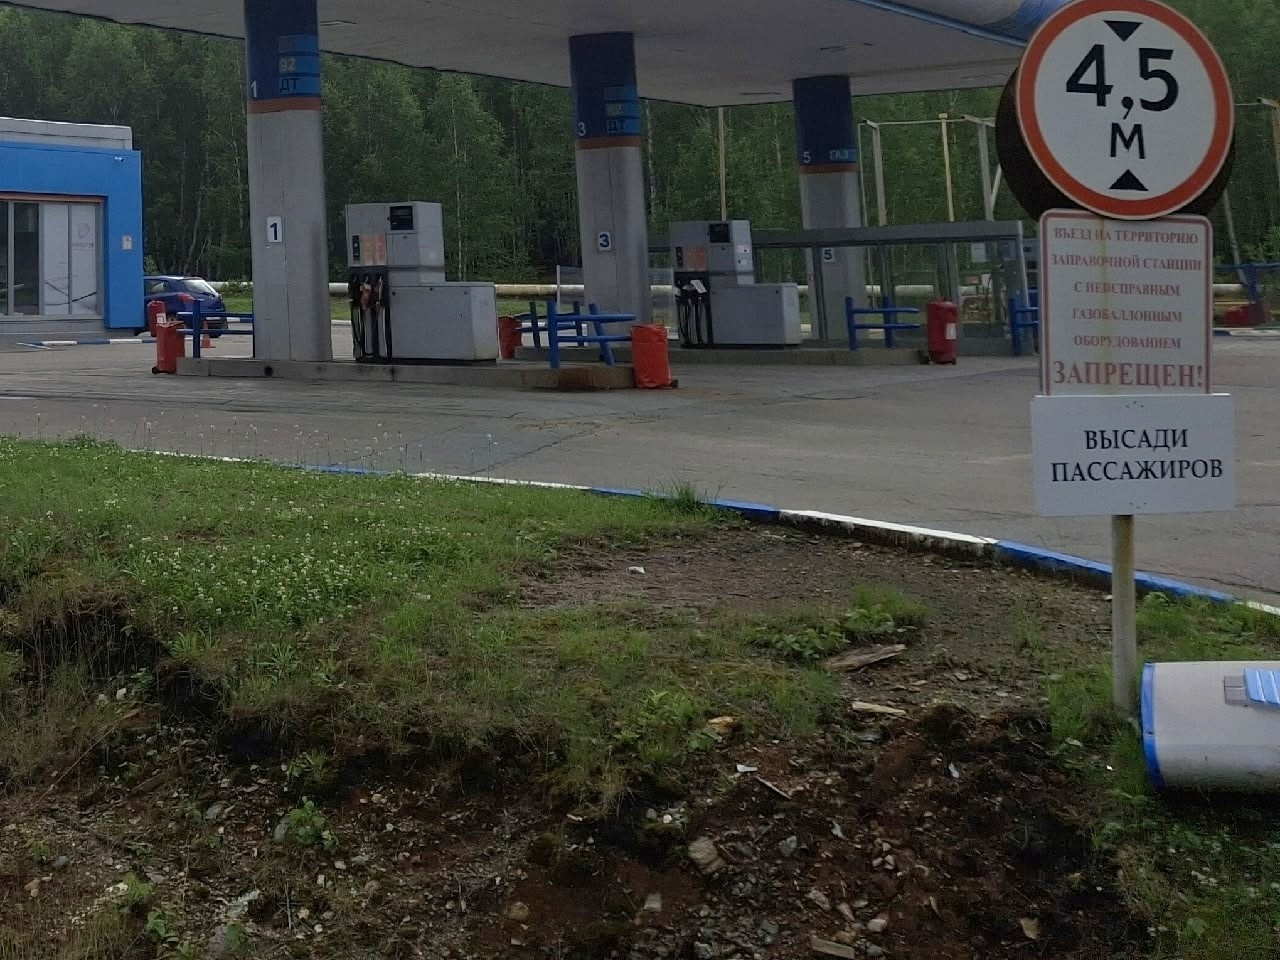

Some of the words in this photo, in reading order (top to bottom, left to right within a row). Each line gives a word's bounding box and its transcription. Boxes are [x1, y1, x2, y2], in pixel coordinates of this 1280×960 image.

[251, 80, 257, 98] 1
[1065, 43, 1179, 119] 4,5
[578, 121, 586, 137] 3
[803, 151, 811, 164] 5
[270, 222, 278, 241] 1
[1115, 230, 1198, 245] ТЕРРИТОРИЮ
[599, 233, 610, 248] 3
[823, 249, 833, 261] 5
[1051, 253, 1140, 269] ЗАПРАВОЧНОЙ
[1143, 257, 1201, 271] СТАНЦИИ
[1074, 281, 1083, 293] С
[1072, 307, 1183, 324] ГАЗОБАЛЛОННЫМ
[1074, 334, 1182, 350] ОБОРУДОВАНИЕМ
[1053, 360, 1203, 390] ЗАПРЕЩЕН!
[1084, 428, 1189, 452] ВЫСАДИ
[1050, 458, 1223, 483] ПАССАЖИРОВ
